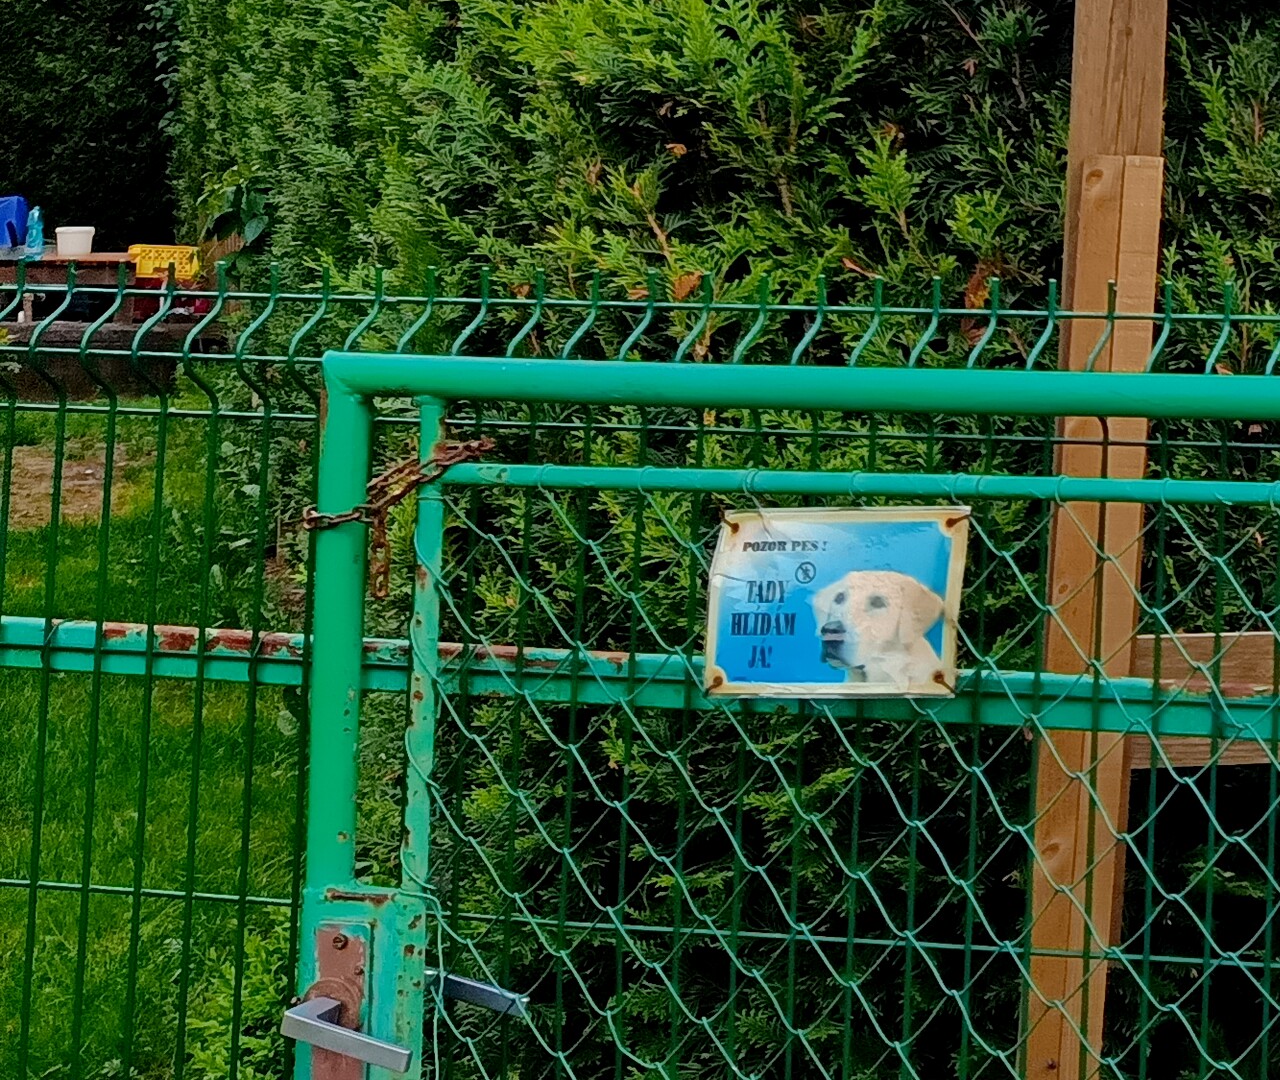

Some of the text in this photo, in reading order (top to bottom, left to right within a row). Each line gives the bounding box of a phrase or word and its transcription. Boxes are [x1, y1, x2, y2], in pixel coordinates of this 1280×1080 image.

[742, 540, 787, 552] POZOR
[746, 580, 789, 604] TADY
[731, 604, 797, 636] HLÍDÁM
[748, 638, 773, 669] JÁ!
